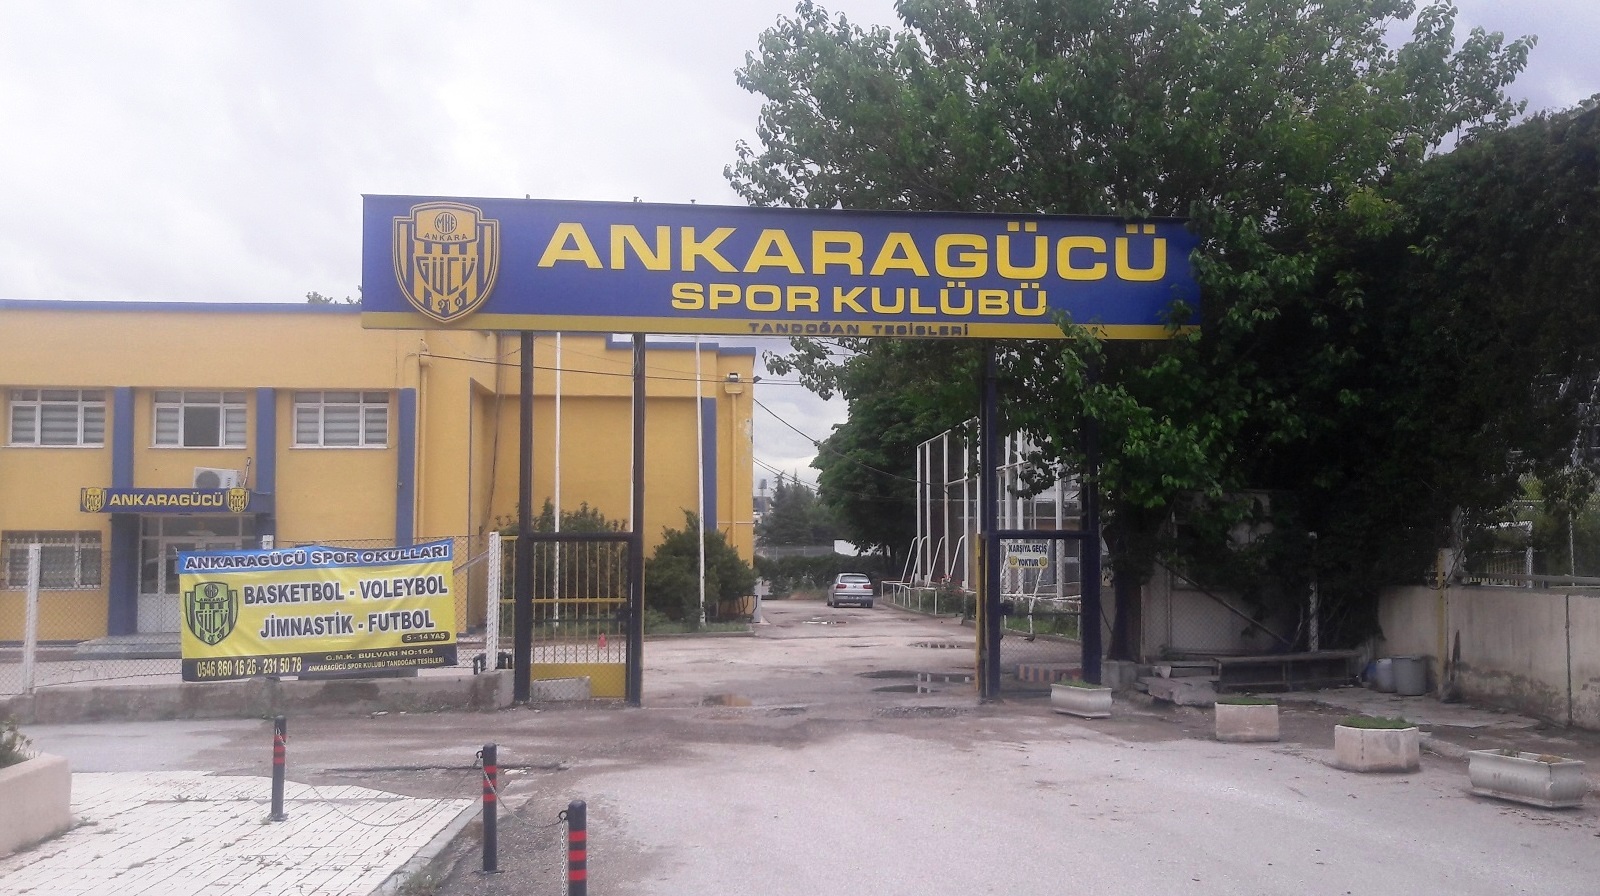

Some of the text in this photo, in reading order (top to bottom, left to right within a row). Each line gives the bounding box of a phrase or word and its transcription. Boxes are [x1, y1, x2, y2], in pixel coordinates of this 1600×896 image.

[436, 213, 455, 233] MKE
[424, 232, 468, 241] ANKARA
[537, 221, 1168, 282] ANKARAGÜCÜ
[670, 281, 1048, 316] SPOR KULÜBÜ
[748, 321, 969, 336] TANDOĞAN TESİSLERİ
[109, 491, 223, 507] ANKARAGÜCÜ
[185, 545, 448, 569] ANKARAGÜCÜ SPOR OKULLARI
[1018, 558, 1039, 567] YOKTUR
[244, 582, 345, 605] BASKETBOL
[359, 575, 448, 599] VOLEYBOL
[260, 611, 353, 637] JİMNASTİK
[368, 610, 435, 632] FUTBOL
[419, 632, 428, 640] 14
[430, 632, 446, 640] YAŞ
[358, 650, 399, 659] BULVARI
[197, 660, 216, 677] 0546
[217, 660, 233, 676] 860
[235, 660, 245, 675] 16
[246, 659, 257, 674] 26
[263, 658, 278, 674] 231
[280, 657, 290, 673] 50
[292, 657, 302, 672] 78
[308, 662, 346, 672] ANKARAGÜCÜ
[386, 657, 417, 667] TANDOĞAN
